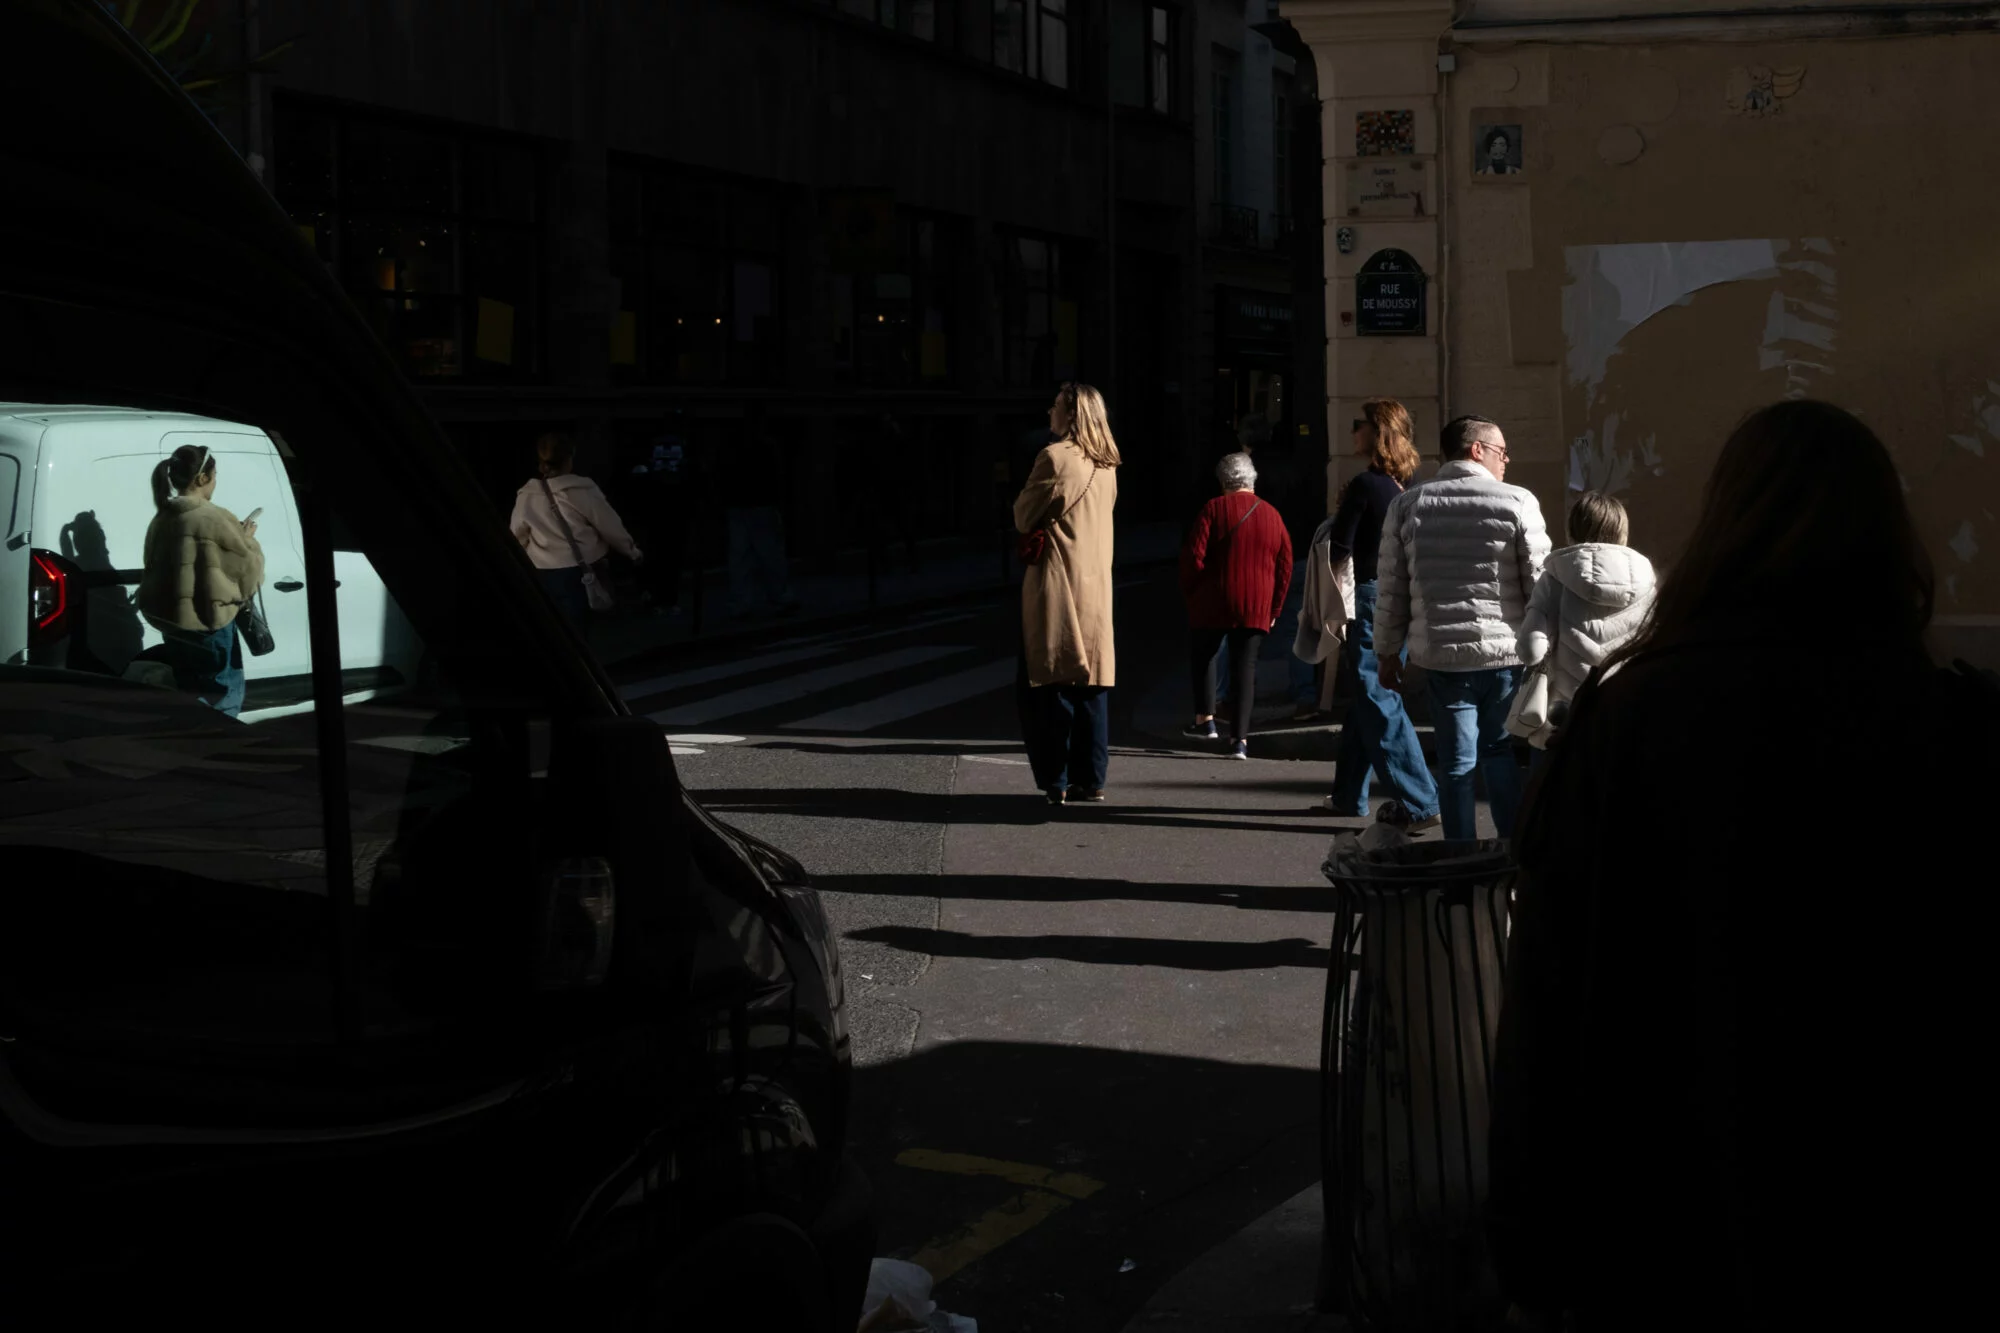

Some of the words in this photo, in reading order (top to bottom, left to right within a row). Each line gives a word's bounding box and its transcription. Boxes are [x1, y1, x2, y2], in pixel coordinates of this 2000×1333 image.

[1380, 284, 1400, 294] RUE
[1362, 298, 1374, 309] DE
[1377, 298, 1417, 309] MOUSSY
